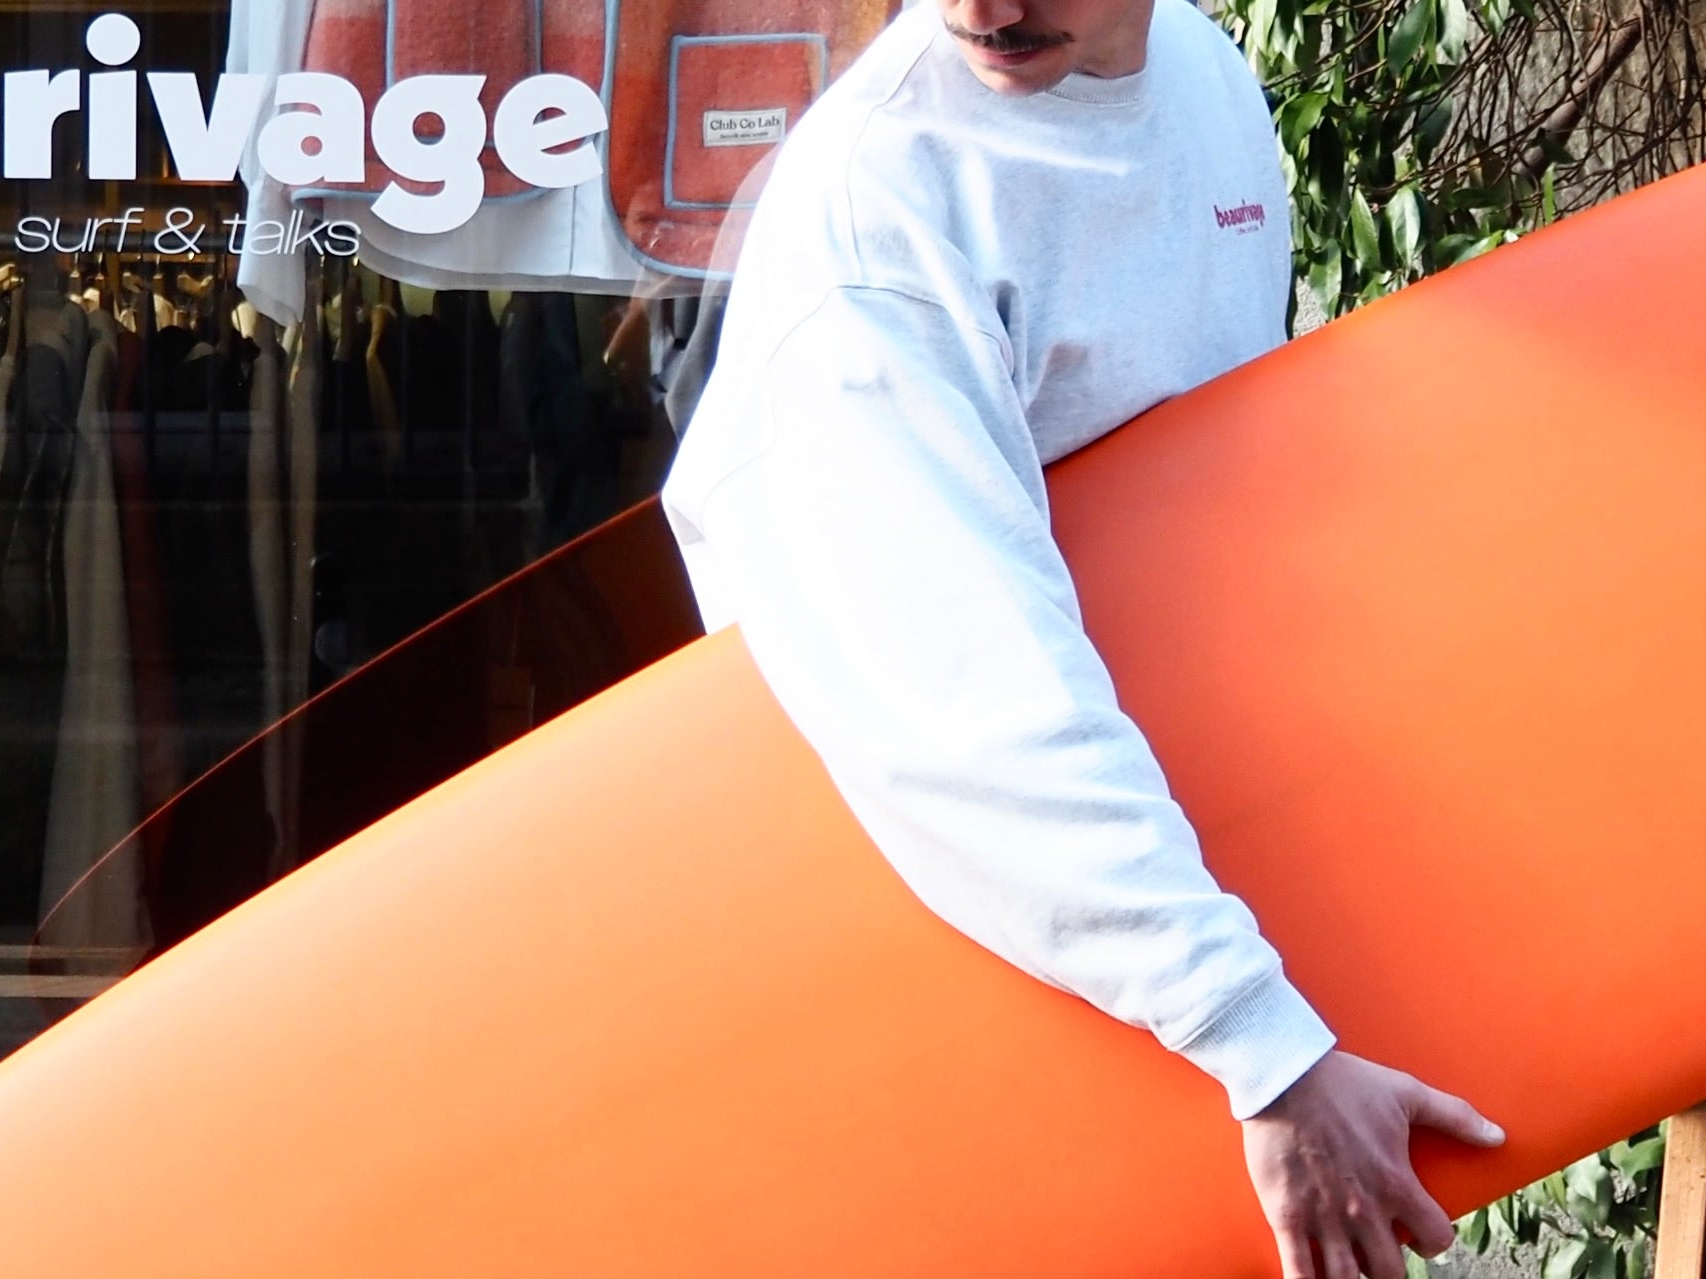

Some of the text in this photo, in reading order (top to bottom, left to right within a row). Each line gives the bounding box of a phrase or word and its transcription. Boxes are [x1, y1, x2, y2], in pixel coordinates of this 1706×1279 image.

[710, 114, 780, 131] Club Co Lab
[14, 207, 144, 253] surf
[154, 207, 205, 255] &
[224, 211, 361, 257] talks
